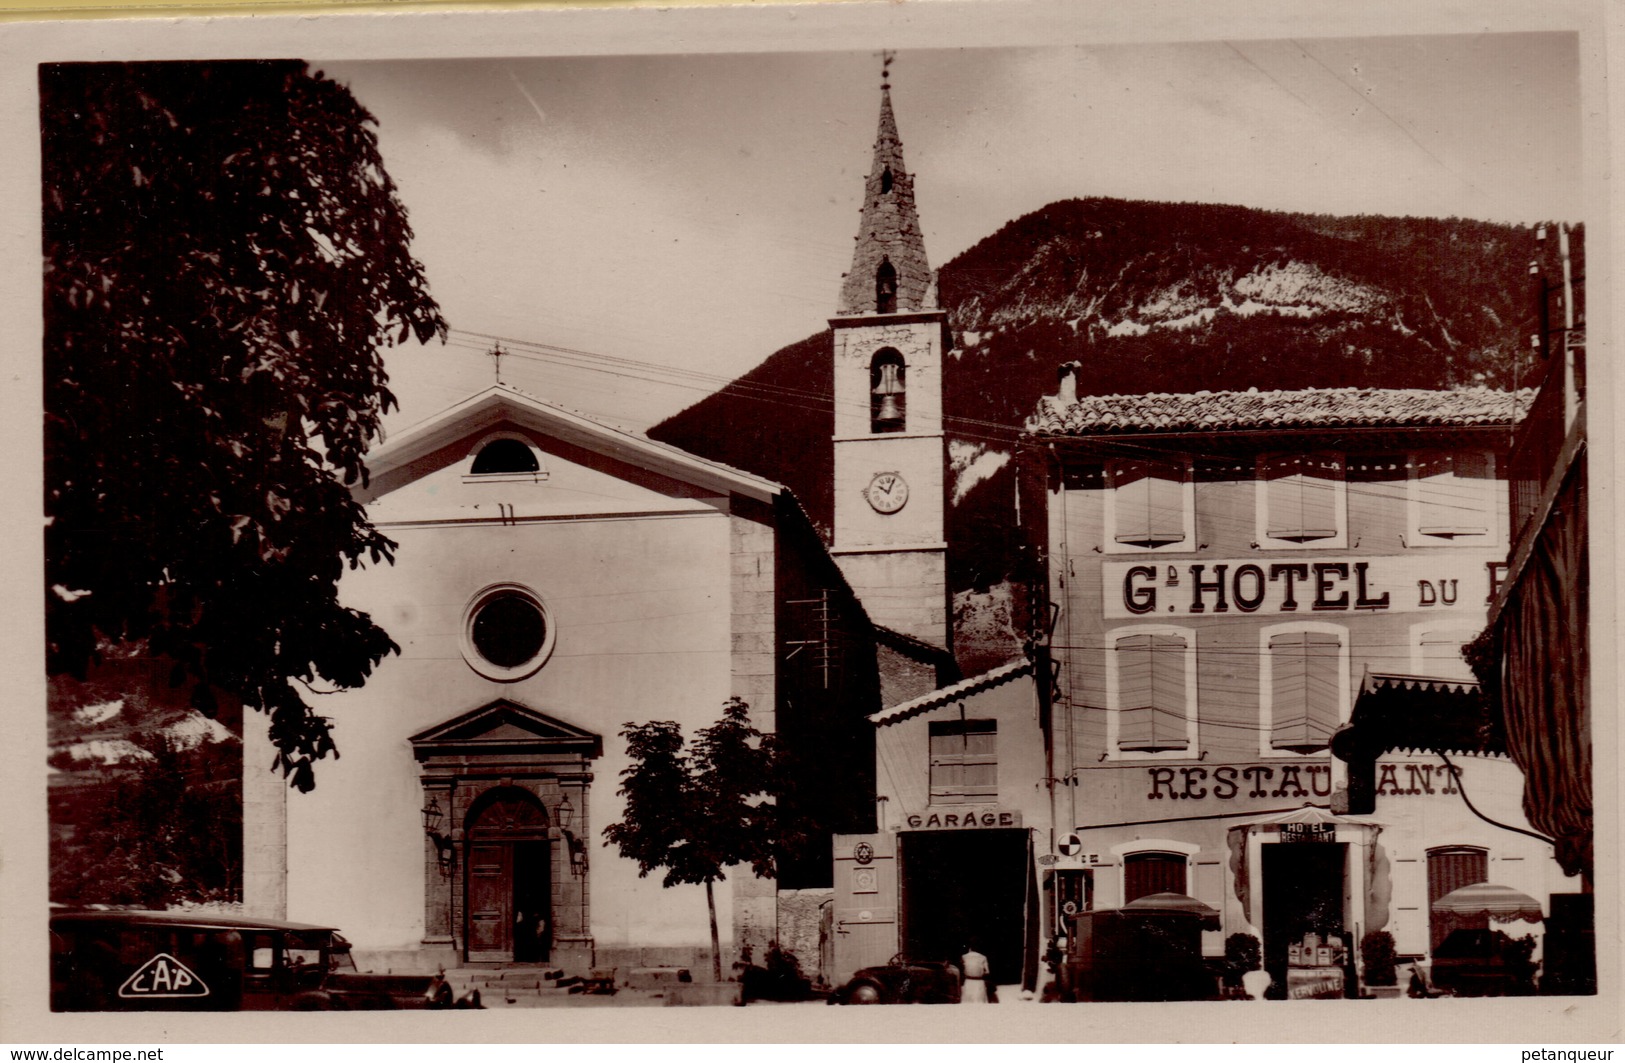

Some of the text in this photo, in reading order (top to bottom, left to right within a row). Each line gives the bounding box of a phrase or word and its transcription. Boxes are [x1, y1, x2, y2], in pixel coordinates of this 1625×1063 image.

[1188, 562, 1390, 613] HOTEL
[1417, 579, 1458, 607] DU
[1147, 765, 1465, 800] RESTAUANT
[907, 812, 1014, 828] GARAGE
